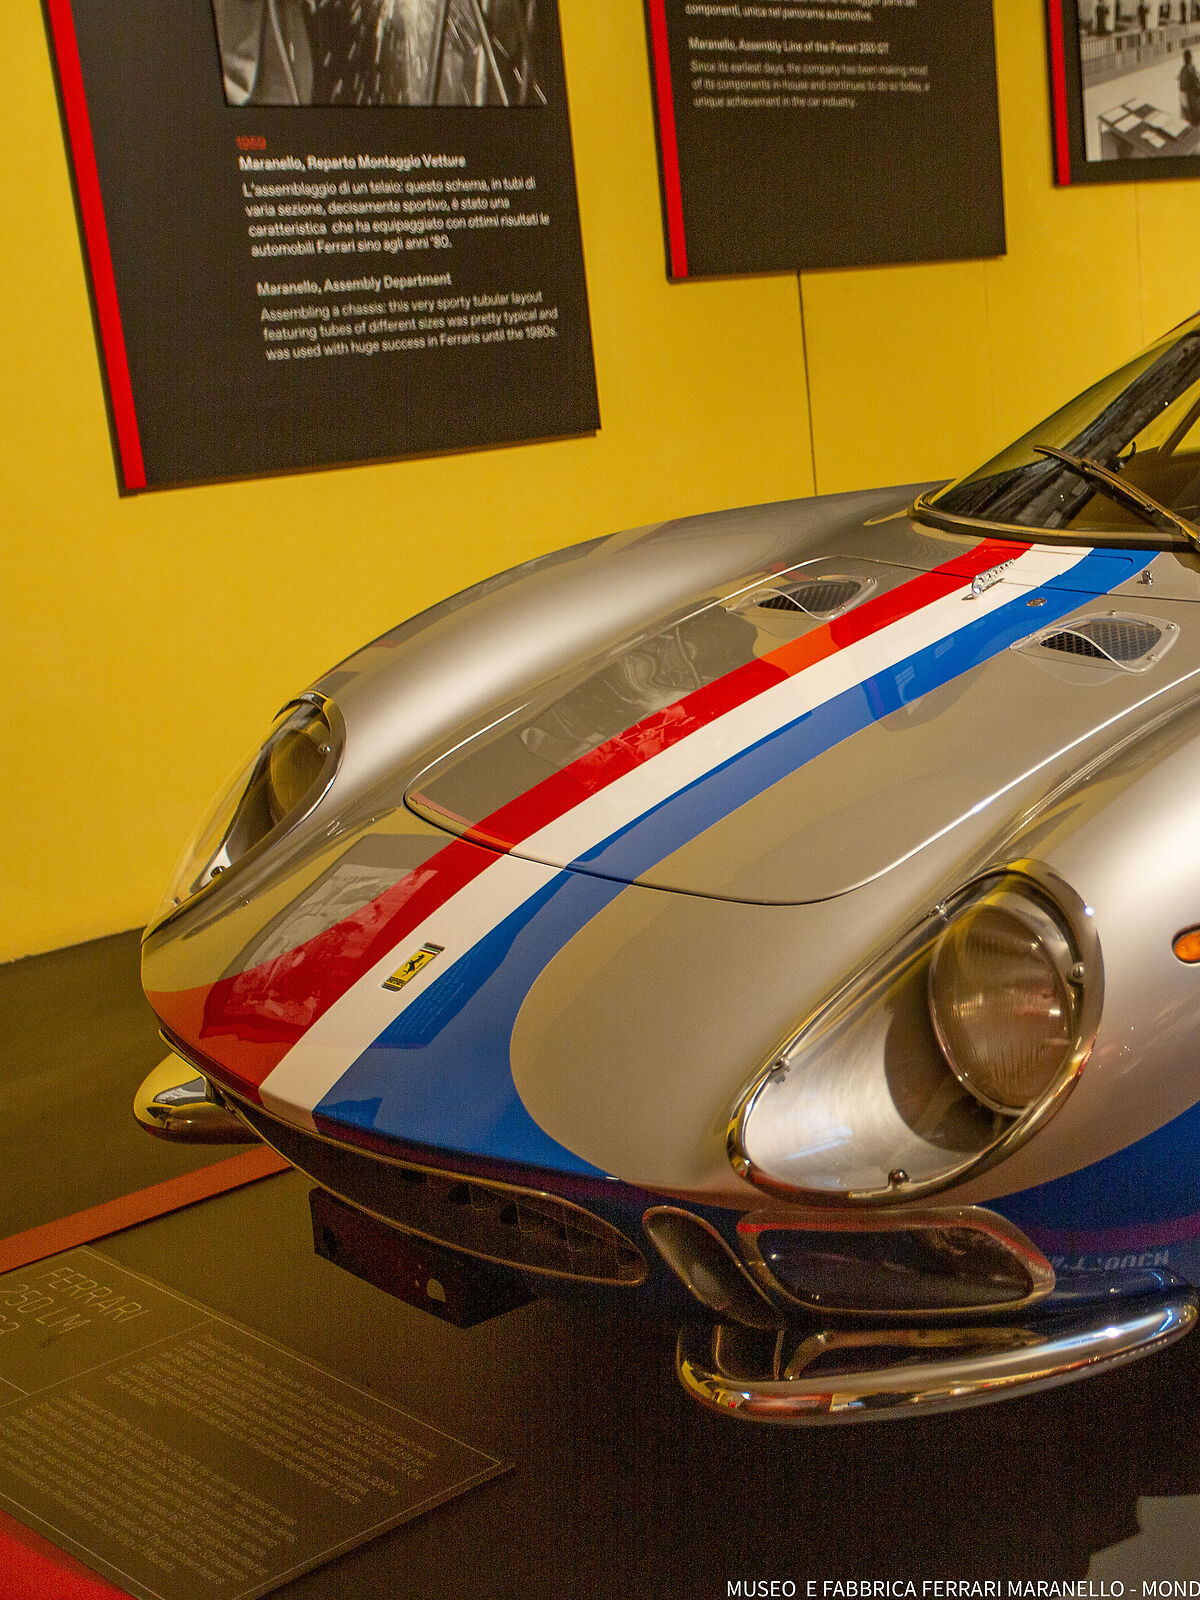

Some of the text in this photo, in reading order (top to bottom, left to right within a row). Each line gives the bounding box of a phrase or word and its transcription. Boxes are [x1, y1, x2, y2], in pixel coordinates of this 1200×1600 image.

[238, 153, 467, 173] Maranello, Reparto Montaggio Vetture
[338, 180, 351, 194] di
[352, 182, 369, 195] un
[404, 179, 444, 195] questo
[491, 177, 502, 188] in
[502, 176, 525, 191] tubi
[525, 176, 537, 190] di
[245, 203, 276, 217] varia
[327, 200, 401, 216] decisamente
[460, 196, 489, 210] stato
[490, 196, 511, 209] una
[248, 212, 551, 238] caratteristica che ha equipaggiato con ottimi risultati le
[251, 240, 316, 257] automobili
[316, 238, 355, 254] Ferrari
[357, 237, 382, 252] sino
[383, 236, 404, 254] agli
[405, 236, 430, 251] anni
[256, 272, 453, 297] Maranello, Assembly Department
[260, 306, 330, 322] Assembling
[331, 305, 340, 318] a
[387, 299, 410, 313] this
[411, 299, 435, 313] very
[436, 296, 471, 311] sporty
[472, 293, 509, 308] tubular
[510, 290, 543, 306] layout
[263, 304, 558, 342] featuring tubes of different sizes was pretty typical and
[265, 350, 291, 361] was
[292, 343, 321, 359] used
[323, 342, 350, 357] with
[350, 340, 380, 356] huge
[381, 335, 426, 351] success
[427, 334, 438, 348] in
[438, 331, 481, 347] Ferraris
[481, 328, 506, 344] until
[506, 326, 524, 342] the
[36, 1266, 149, 1323] FERRARI
[0, 1284, 54, 1313] 250
[36, 1306, 92, 1334] LM
